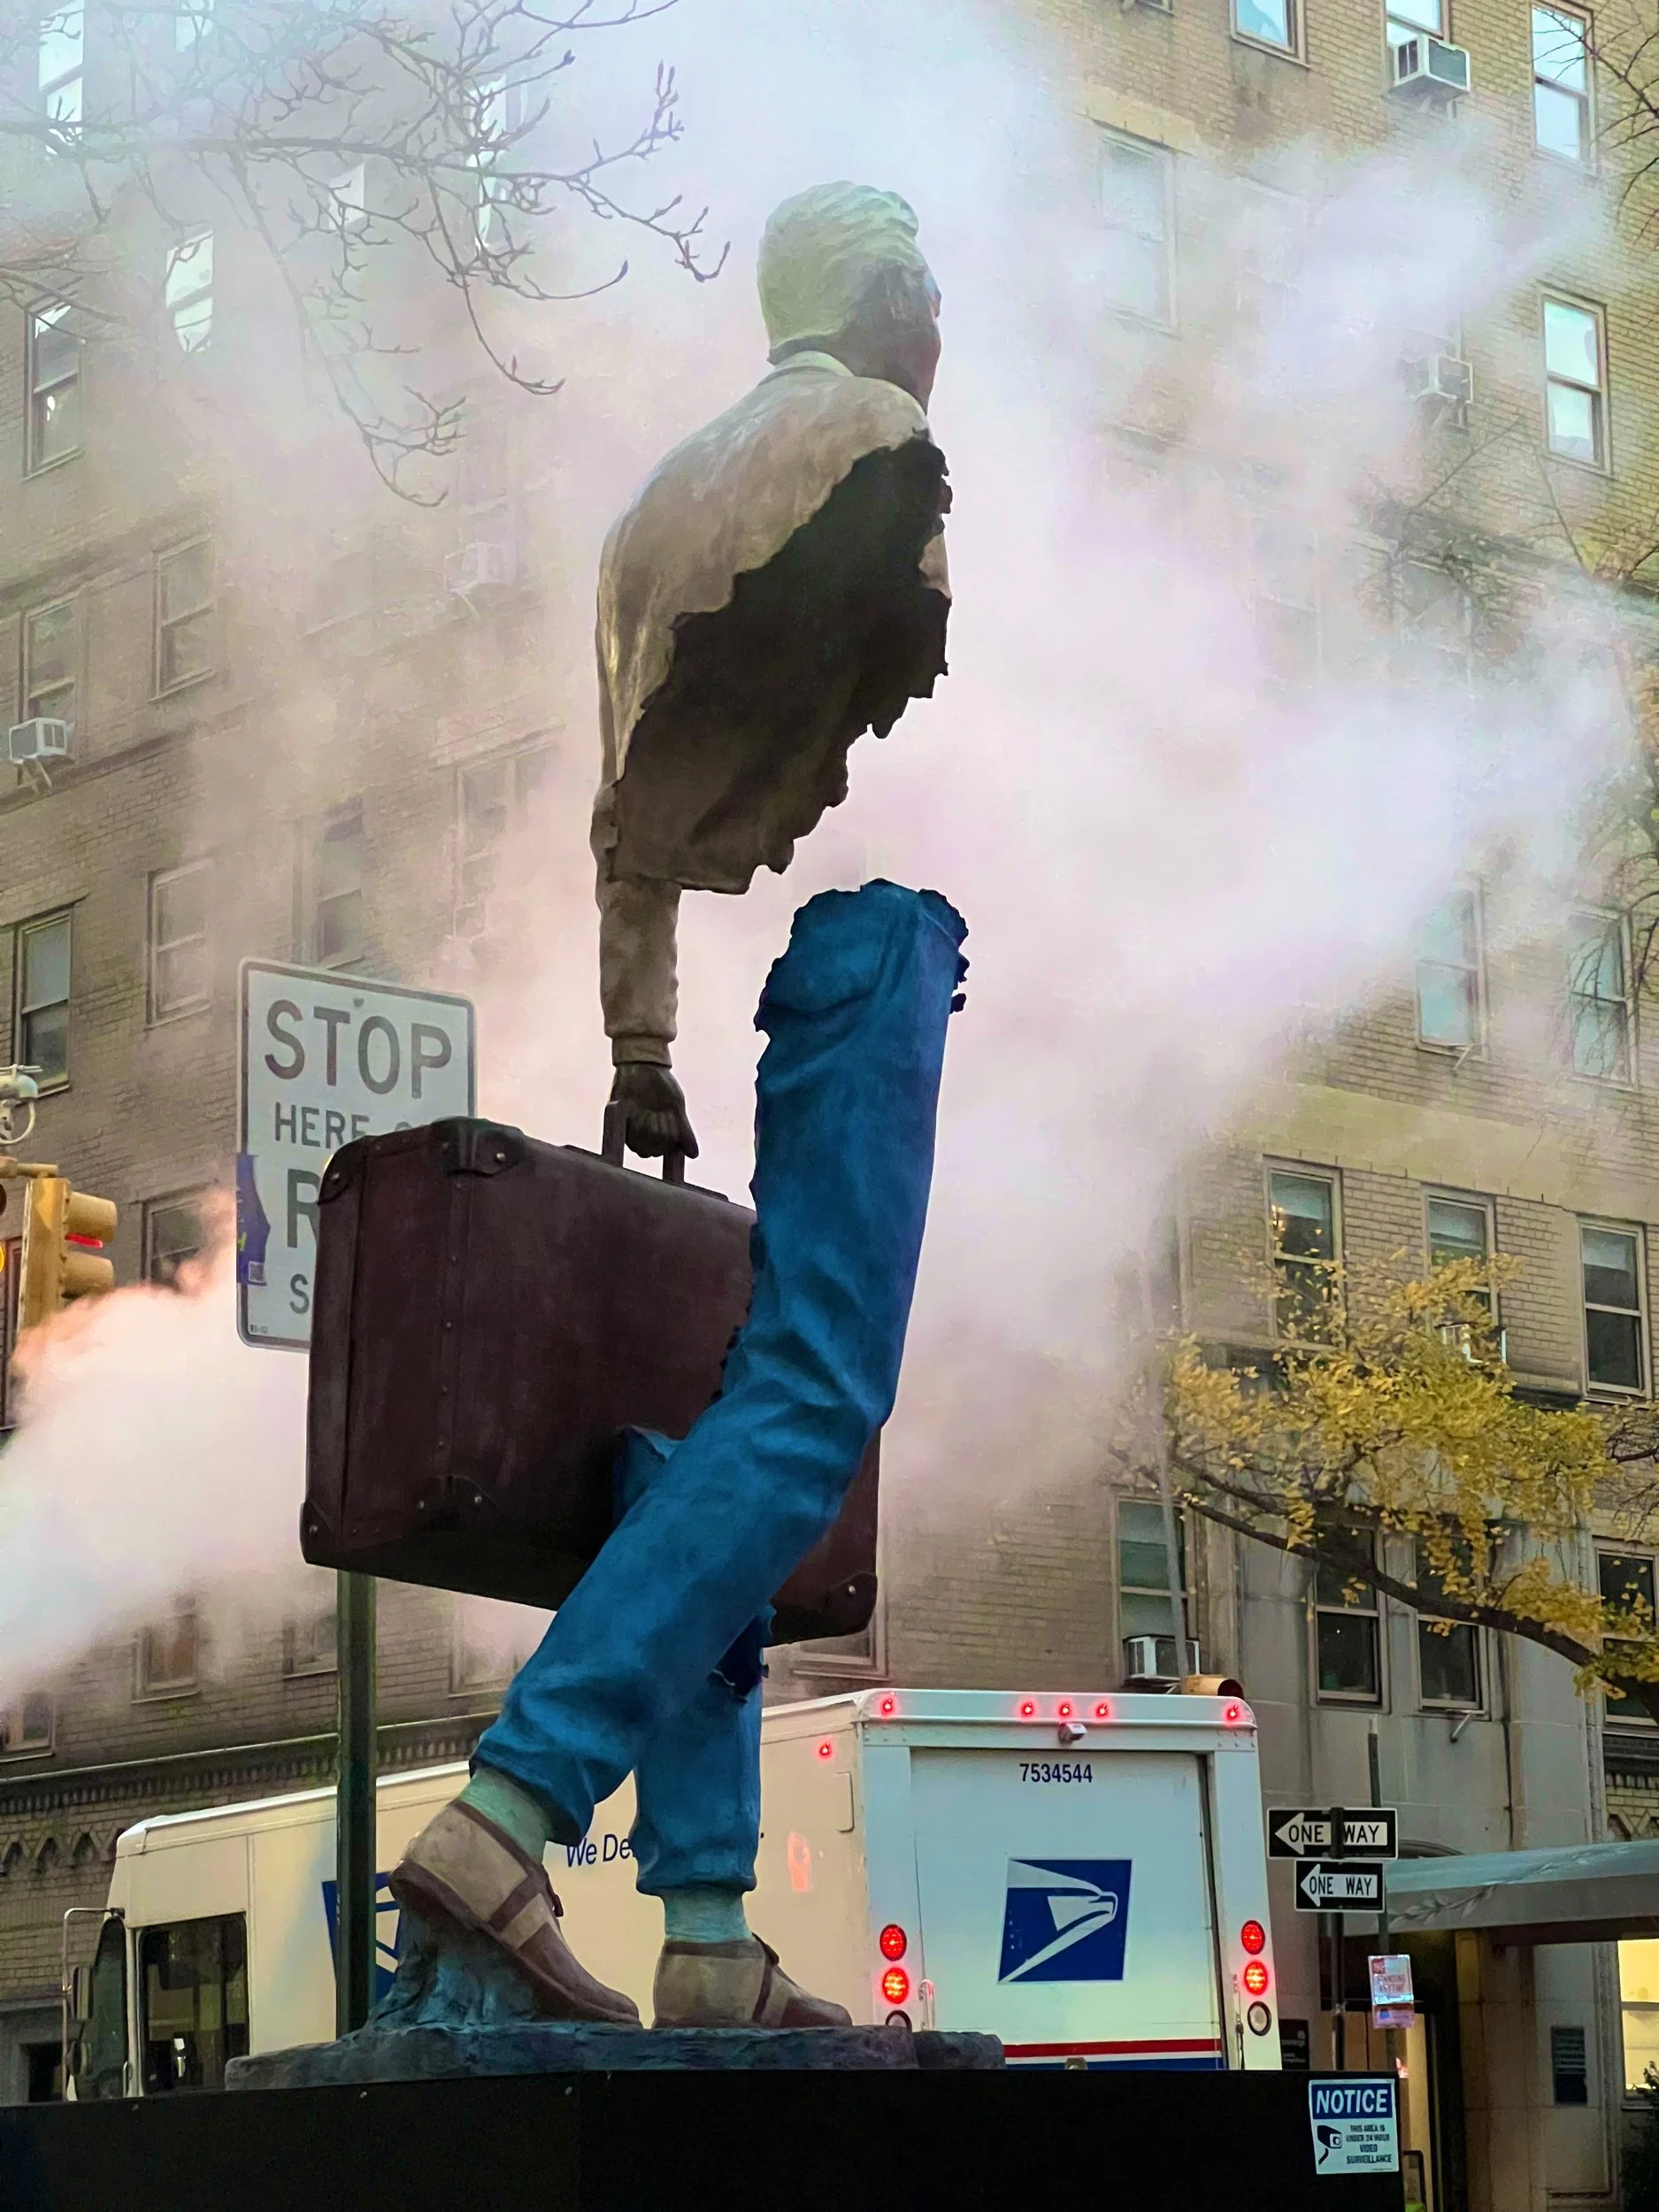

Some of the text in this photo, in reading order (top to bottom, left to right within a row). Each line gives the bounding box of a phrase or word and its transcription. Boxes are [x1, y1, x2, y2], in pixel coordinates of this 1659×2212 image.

[265, 999, 452, 1100] STOP
[274, 1102, 370, 1149] HERE
[1019, 1763, 1093, 1784] 7534544
[1288, 1824, 1380, 1843] ONE WAY
[566, 1833, 635, 1868] We De
[1310, 1876, 1372, 1896] ONE WAY
[1316, 2089, 1388, 2115] NOTICE
[1347, 2154, 1392, 2164] SURVEILLANCE
